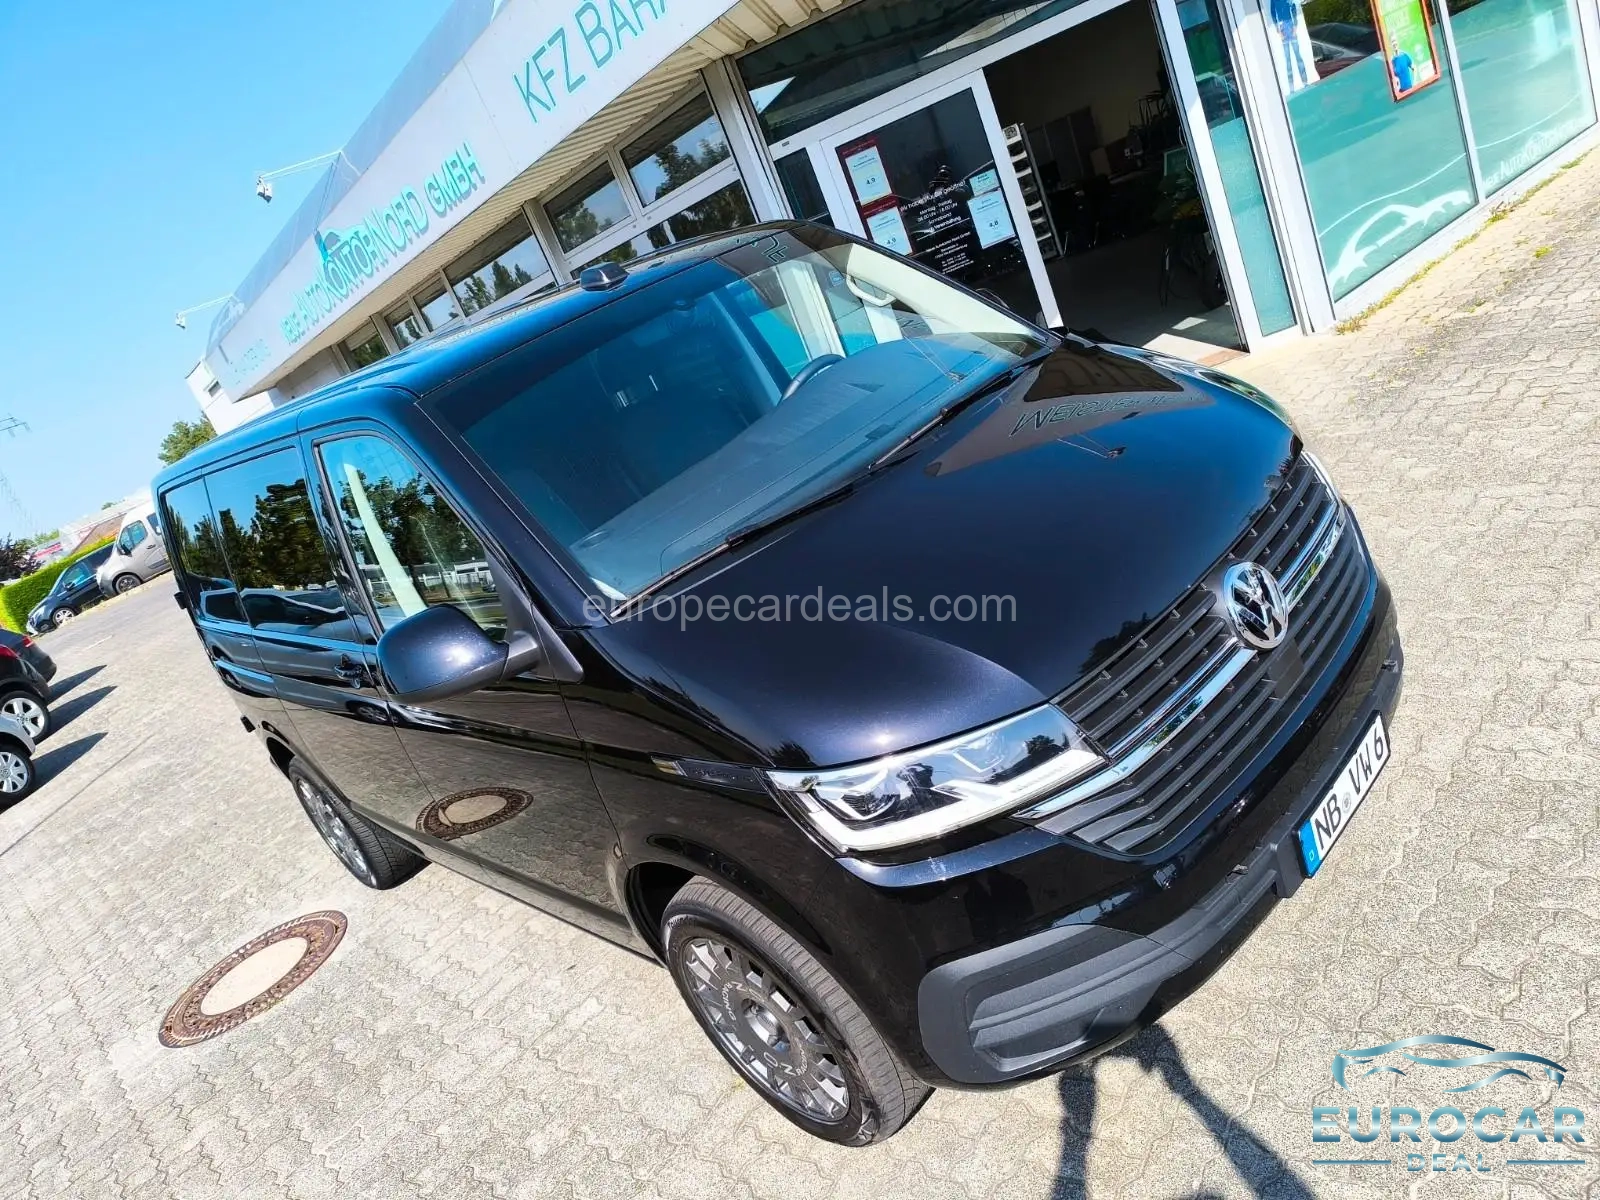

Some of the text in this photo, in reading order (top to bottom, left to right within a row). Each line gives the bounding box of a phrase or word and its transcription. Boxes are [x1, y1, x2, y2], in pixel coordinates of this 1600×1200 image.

[513, 26, 586, 123] KFZ
[1314, 727, 1384, 850] NB VW 6
